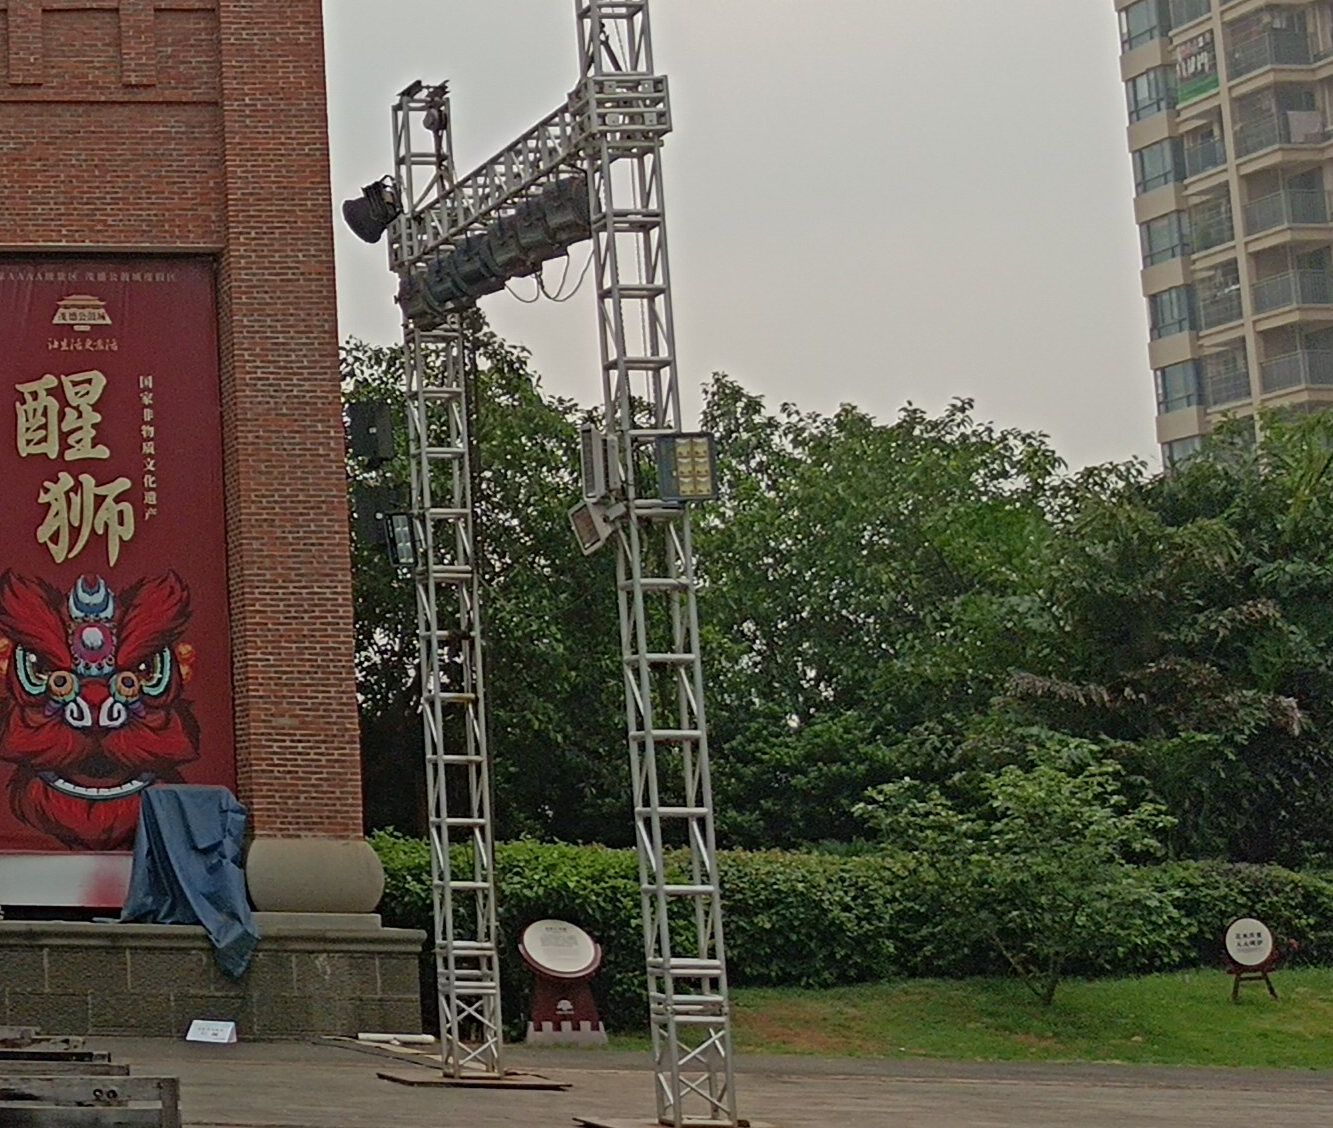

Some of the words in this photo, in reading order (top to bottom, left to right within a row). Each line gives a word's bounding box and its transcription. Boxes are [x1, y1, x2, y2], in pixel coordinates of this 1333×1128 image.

[14, 369, 135, 568] 醒狮
[138, 374, 158, 521] 国家非物质文化遗产
